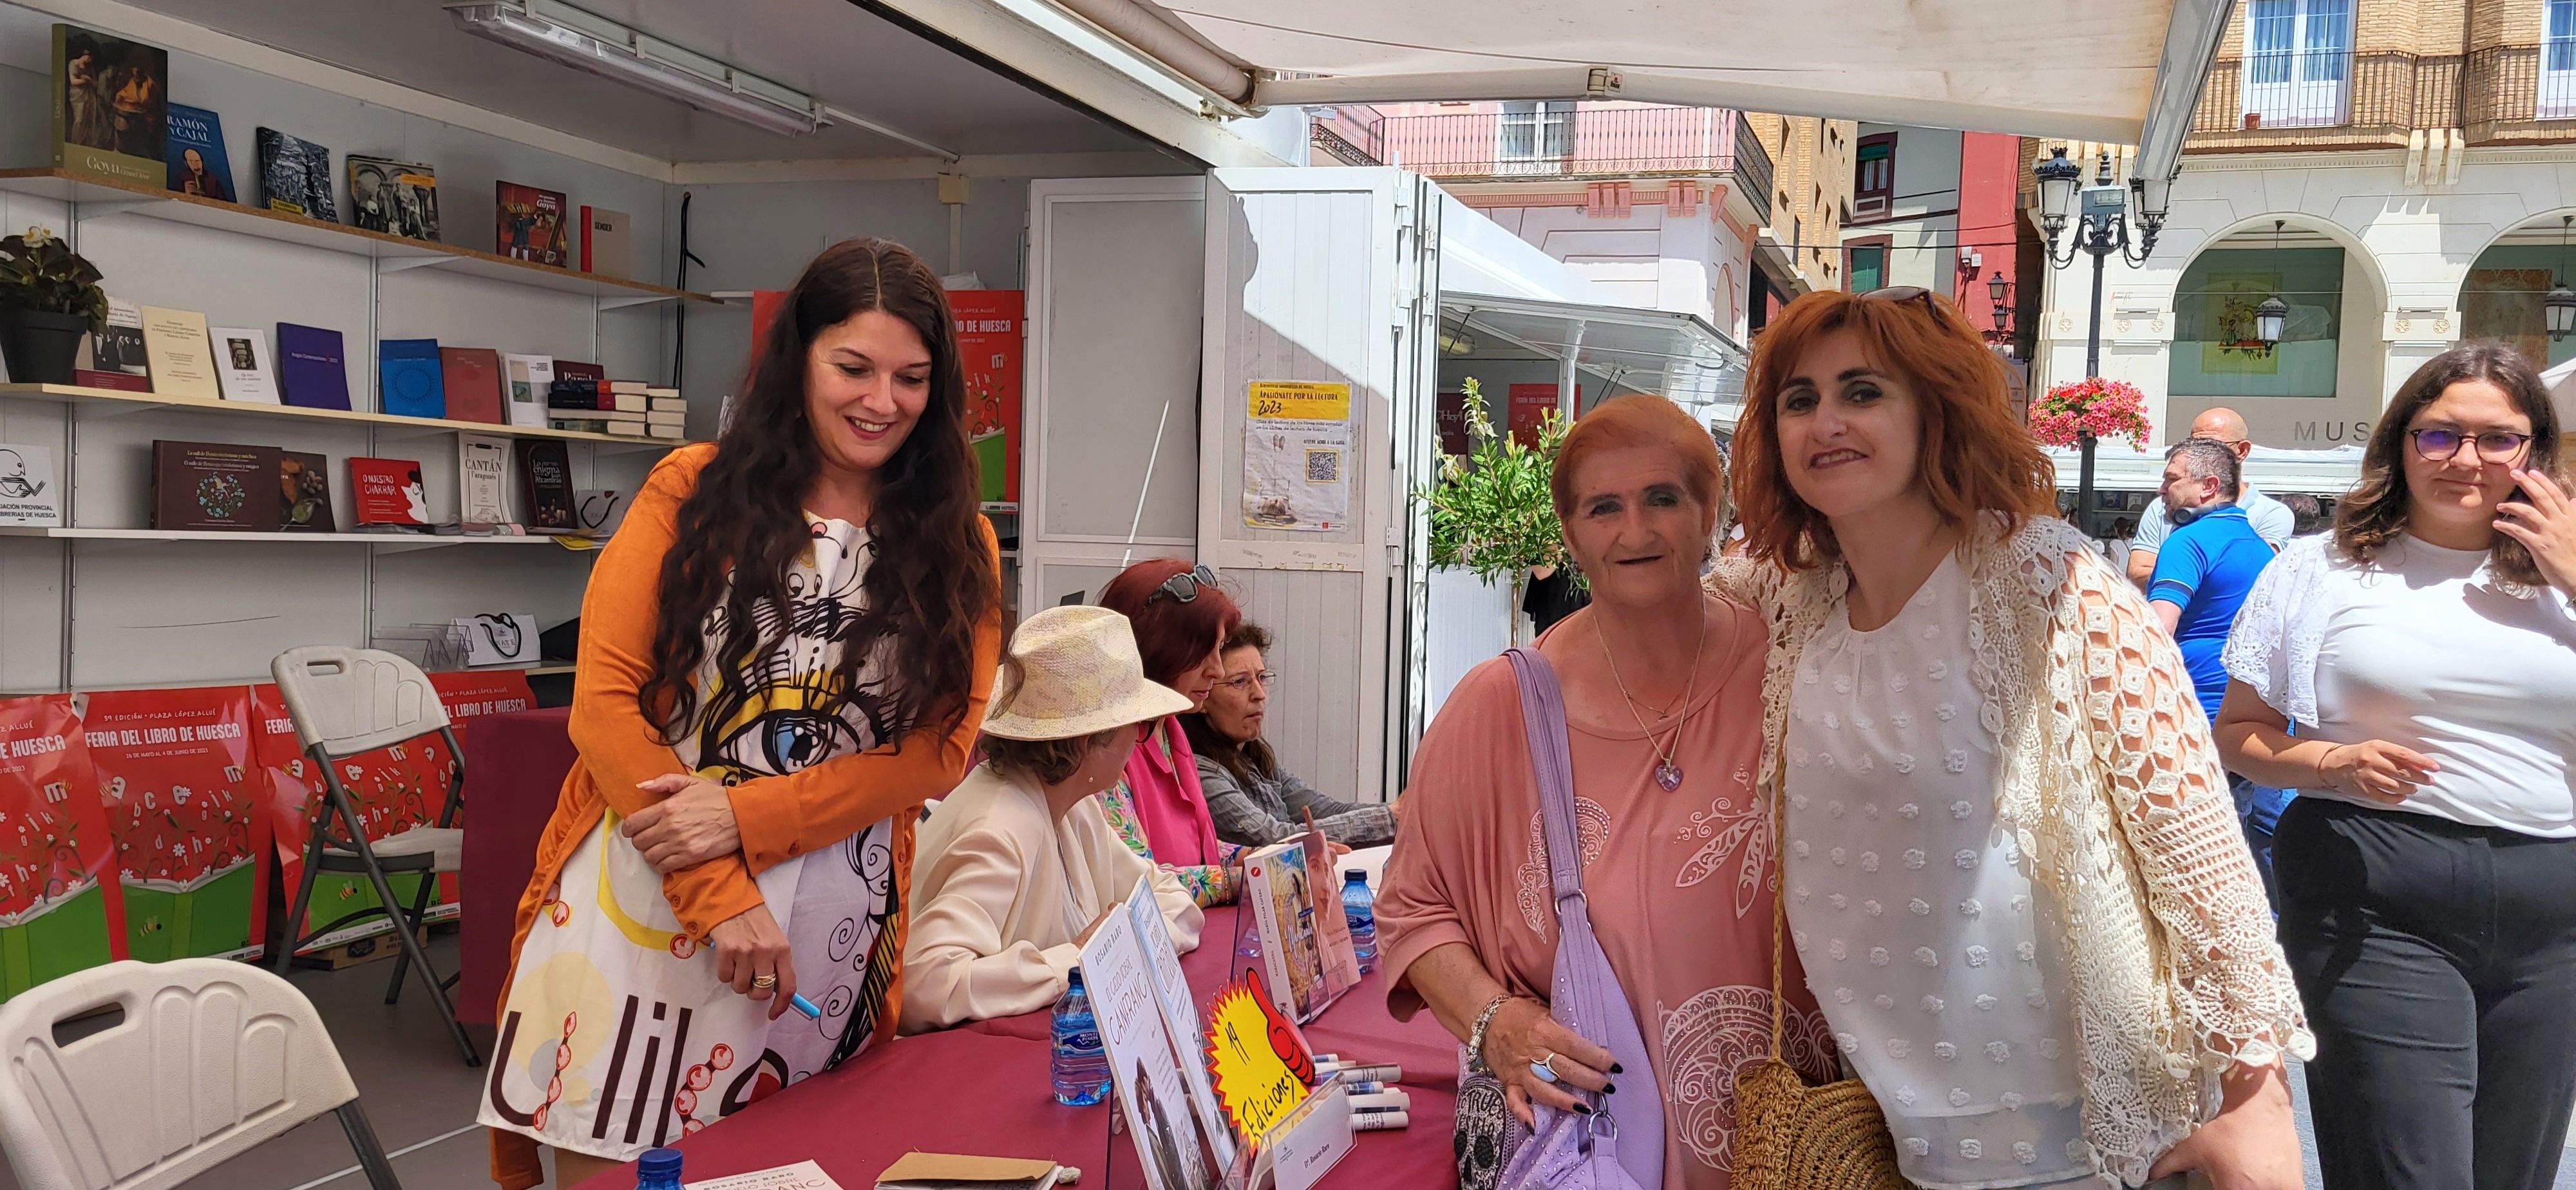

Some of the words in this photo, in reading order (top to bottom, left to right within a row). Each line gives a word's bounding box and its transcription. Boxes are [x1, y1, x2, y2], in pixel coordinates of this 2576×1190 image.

[167, 115, 208, 133] RAMÓN
[176, 127, 211, 142] CAJAL
[86, 155, 119, 175] Goya
[536, 199, 556, 211] Goya
[967, 319, 978, 332] DE
[980, 319, 1011, 332] HUESCA
[1258, 399, 1282, 416] 2023
[465, 458, 502, 472] CANTÁN
[368, 475, 393, 484] NUESTRO
[365, 484, 397, 496] CHARRAR
[115, 712, 142, 721] EDICIÓN
[197, 707, 216, 716] ALLUÉ
[455, 702, 480, 717] LIBRO
[482, 701, 493, 715] DE
[495, 698, 526, 713] HUESCA
[9, 720, 33, 732] ALLUÉ
[84, 730, 119, 748] FERIA
[120, 729, 142, 746] DEL
[144, 727, 177, 744] LIBRO
[179, 726, 194, 742] DE
[195, 722, 242, 741] HUESCA
[10, 734, 66, 758] HUESCA
[223, 764, 243, 783] m
[44, 782, 68, 804] m
[110, 776, 126, 800] a
[172, 785, 187, 805] e
[133, 801, 142, 817] b
[144, 791, 156, 809] c
[155, 834, 164, 850] d
[191, 836, 204, 854] h
[15, 864, 30, 883] h
[1095, 941, 1112, 967] ROSARIO
[1111, 924, 1122, 944] RARO
[1109, 972, 1148, 1046] CANFRANC
[1225, 1021, 1251, 1066] 19
[1242, 1070, 1294, 1140] Ediciones
[762, 1171, 794, 1182] RARO
